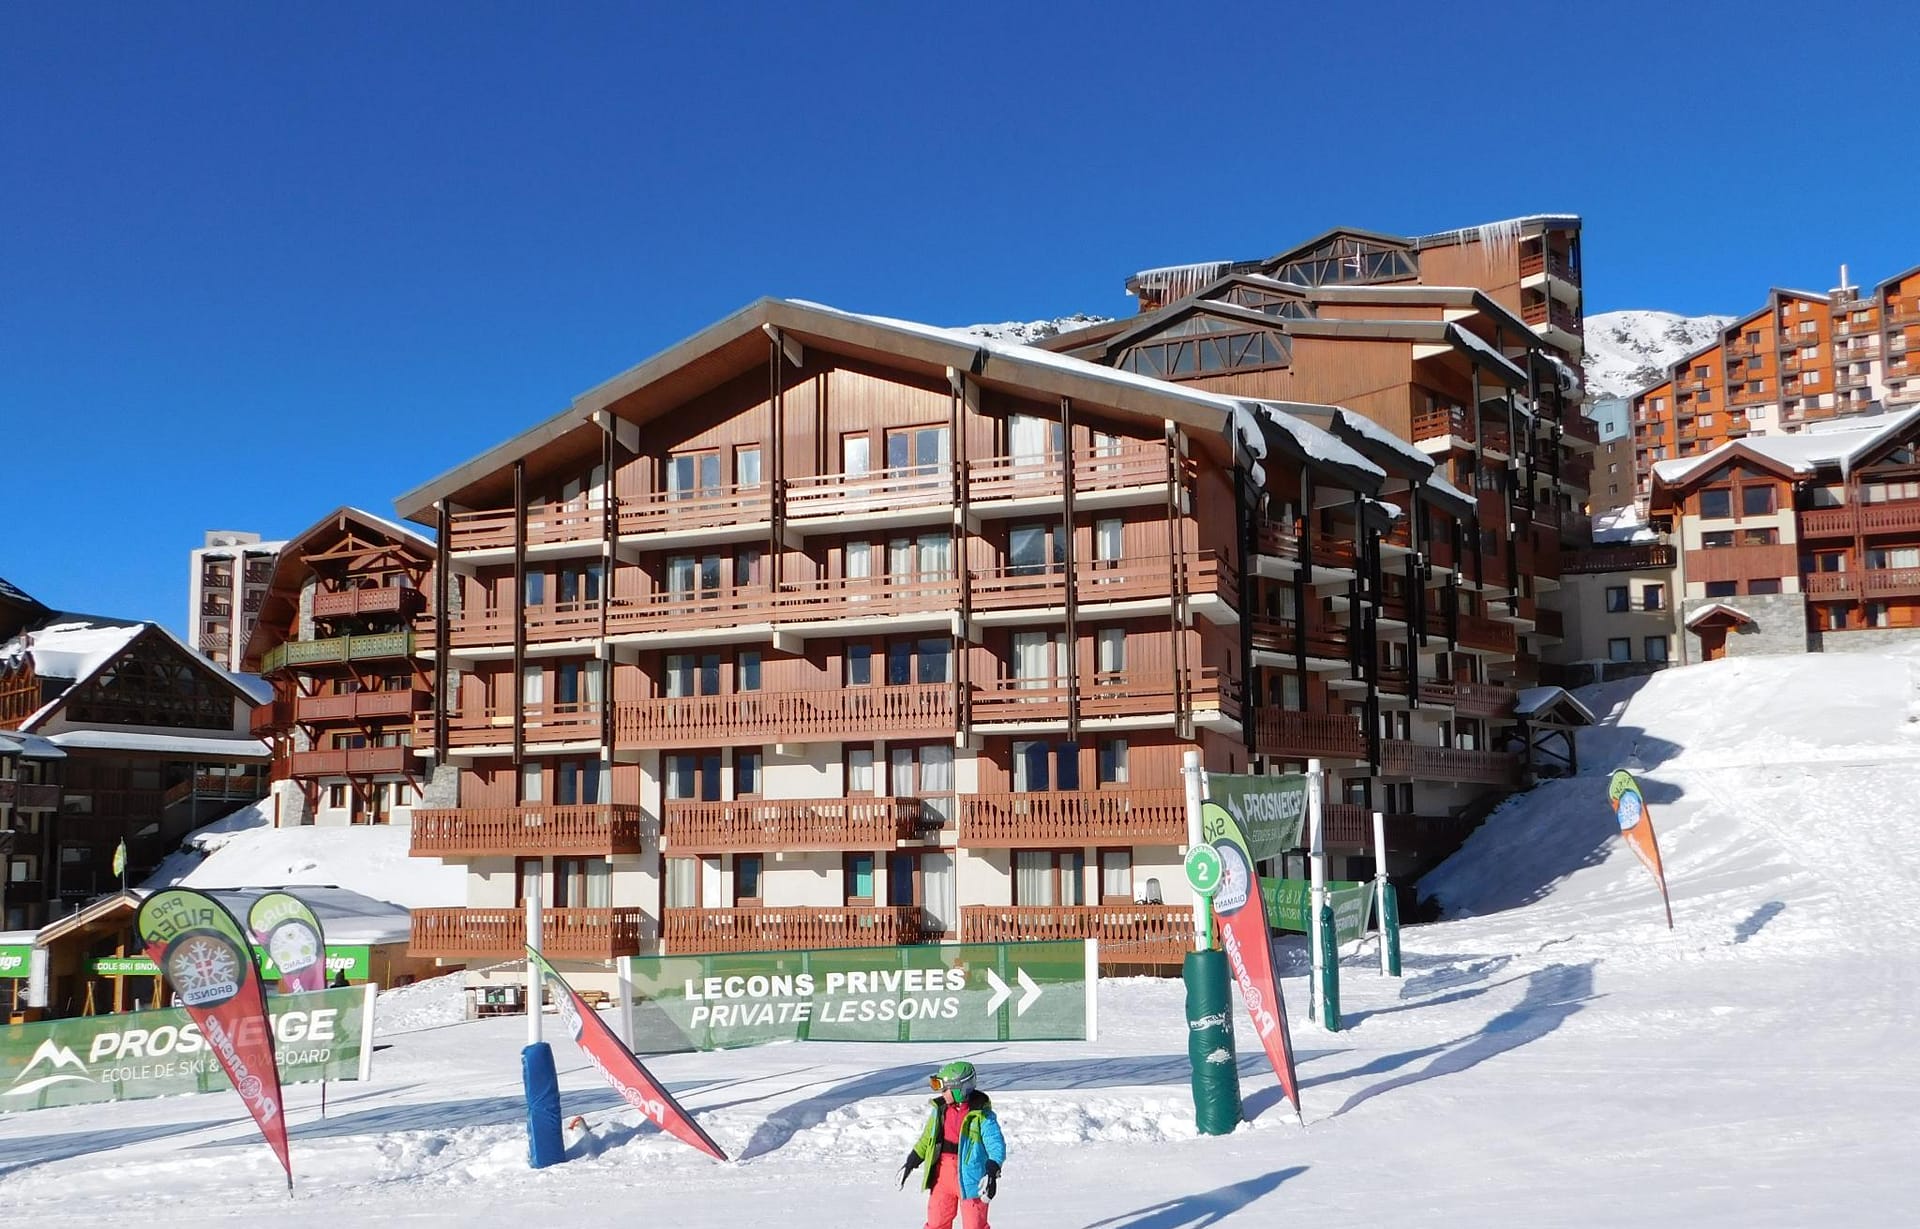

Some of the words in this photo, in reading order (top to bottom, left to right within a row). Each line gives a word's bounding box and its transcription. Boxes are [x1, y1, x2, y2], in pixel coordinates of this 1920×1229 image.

[1197, 862, 1209, 881] 2
[119, 962, 133, 971] SKI
[685, 973, 815, 1001] LECONS
[826, 968, 966, 995] PRIVEES
[690, 1001, 813, 1029] PRIVATE
[819, 997, 960, 1023] LESSONS
[90, 1008, 337, 1063] PROSEIGE
[102, 1064, 150, 1083] ECOLE
[155, 1063, 174, 1078] DE
[180, 1060, 204, 1076] SKI
[208, 1058, 219, 1072] &
